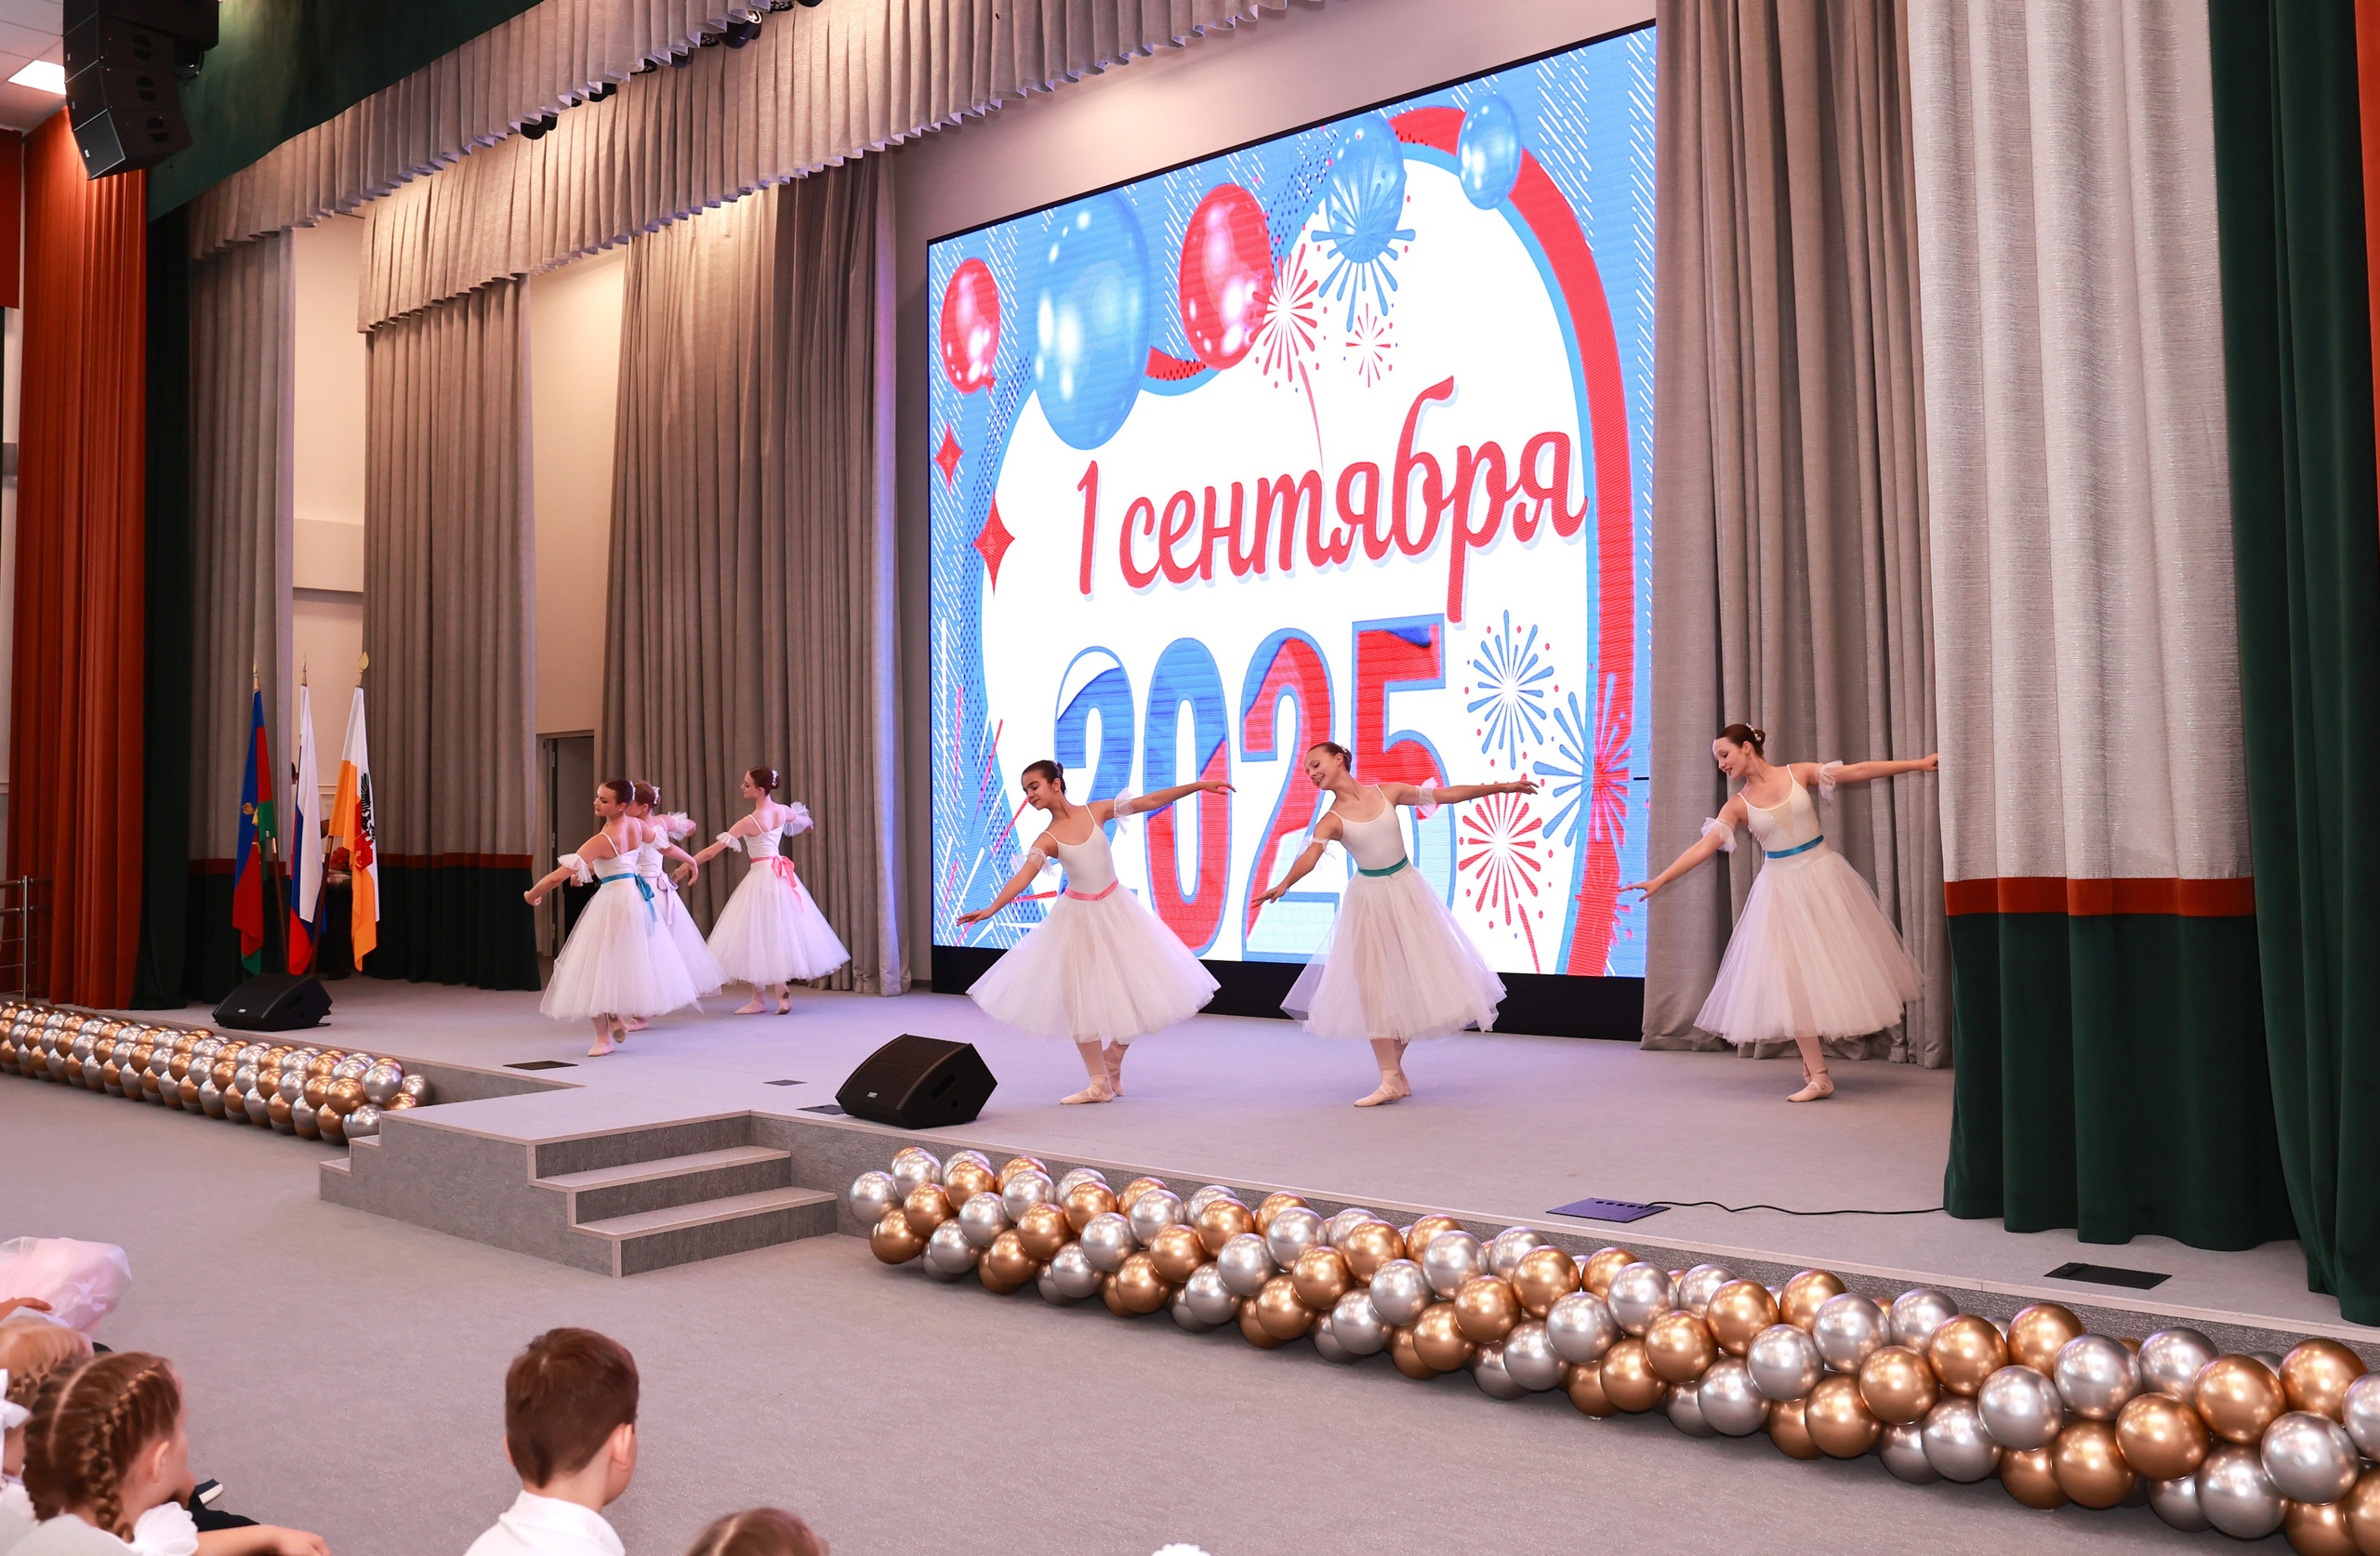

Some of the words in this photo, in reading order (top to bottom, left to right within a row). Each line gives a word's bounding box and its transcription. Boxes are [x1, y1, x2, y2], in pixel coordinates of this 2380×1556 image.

[1077, 460, 1100, 596] 1
[1119, 375, 1588, 624] сентября
[1053, 613, 1457, 963] 2025
